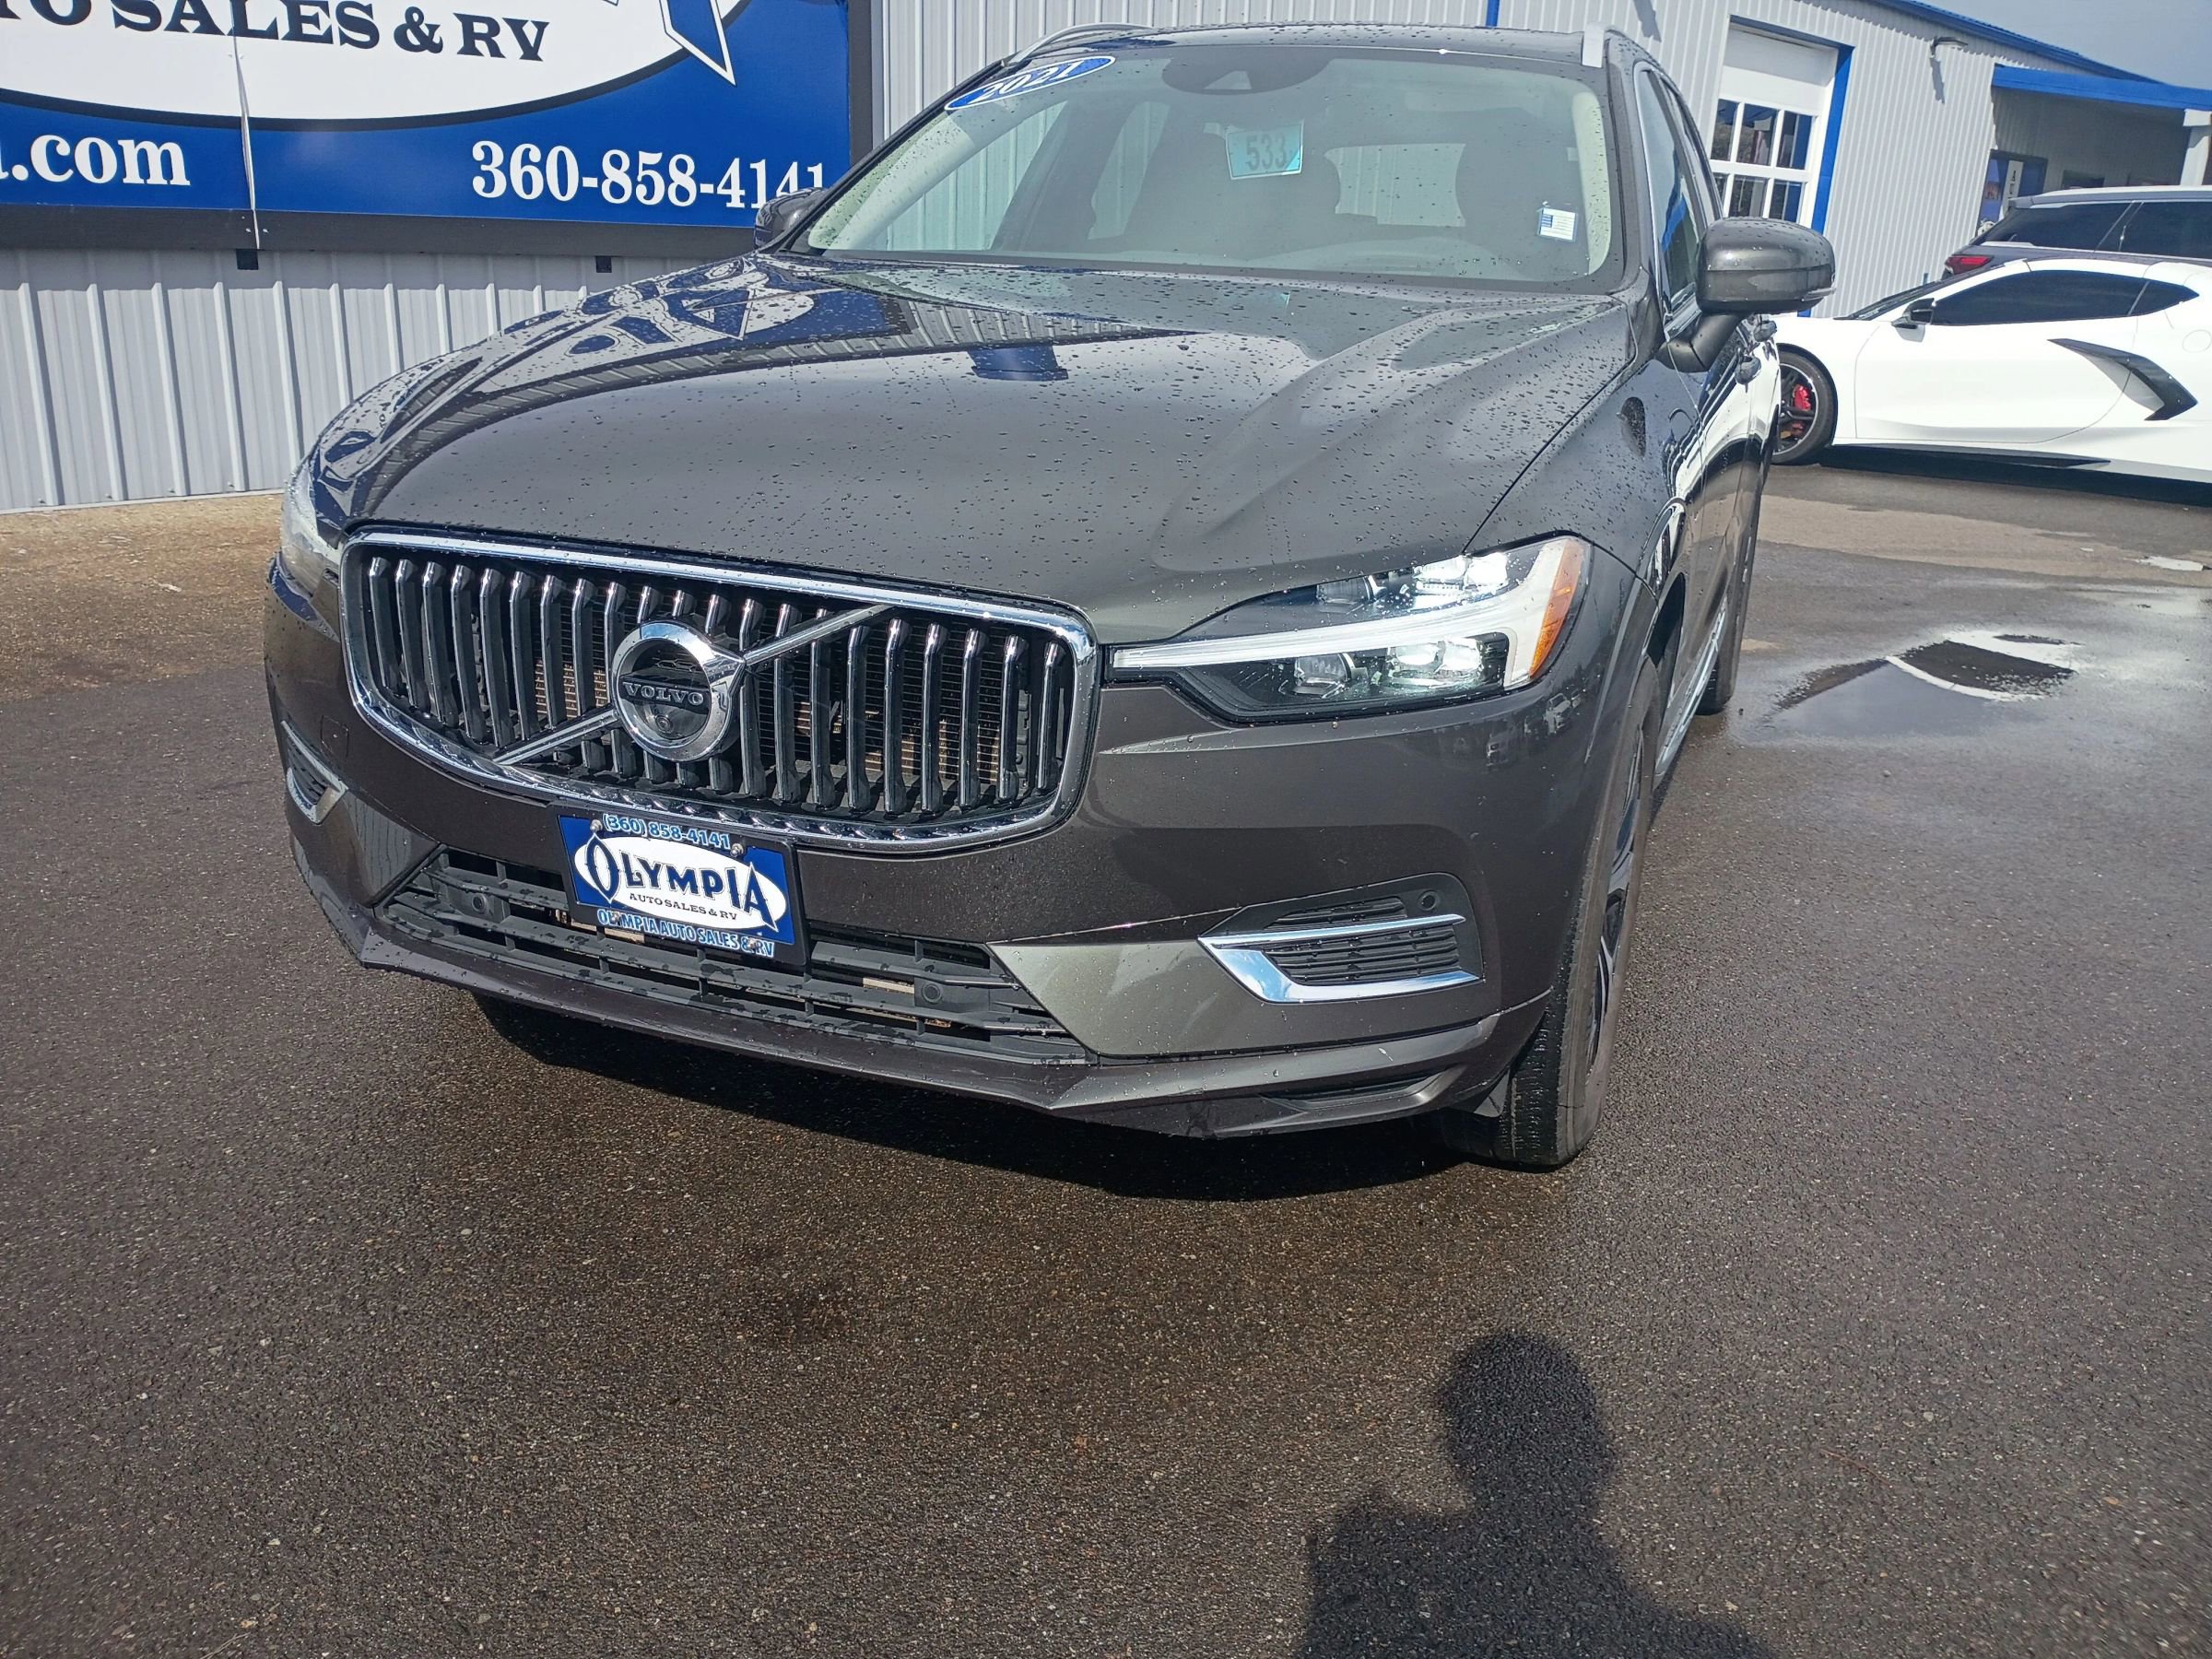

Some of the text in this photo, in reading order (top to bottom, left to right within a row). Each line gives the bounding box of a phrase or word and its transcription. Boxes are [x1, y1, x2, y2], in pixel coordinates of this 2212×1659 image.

[110, 0, 380, 50] SALES
[394, 6, 443, 54] &
[453, 12, 550, 62] RV
[967, 59, 1085, 105] 2021
[0, 135, 191, 186] .com
[622, 681, 704, 706] VOLVO
[603, 813, 731, 850] (360) 858-4141
[585, 833, 779, 933] OLYMPIA
[629, 892, 737, 921] AUTO SALES & RV
[597, 909, 659, 935] OLMPIA
[660, 920, 697, 942] AUTO
[697, 927, 740, 951] SALES
[755, 938, 775, 958] RV
